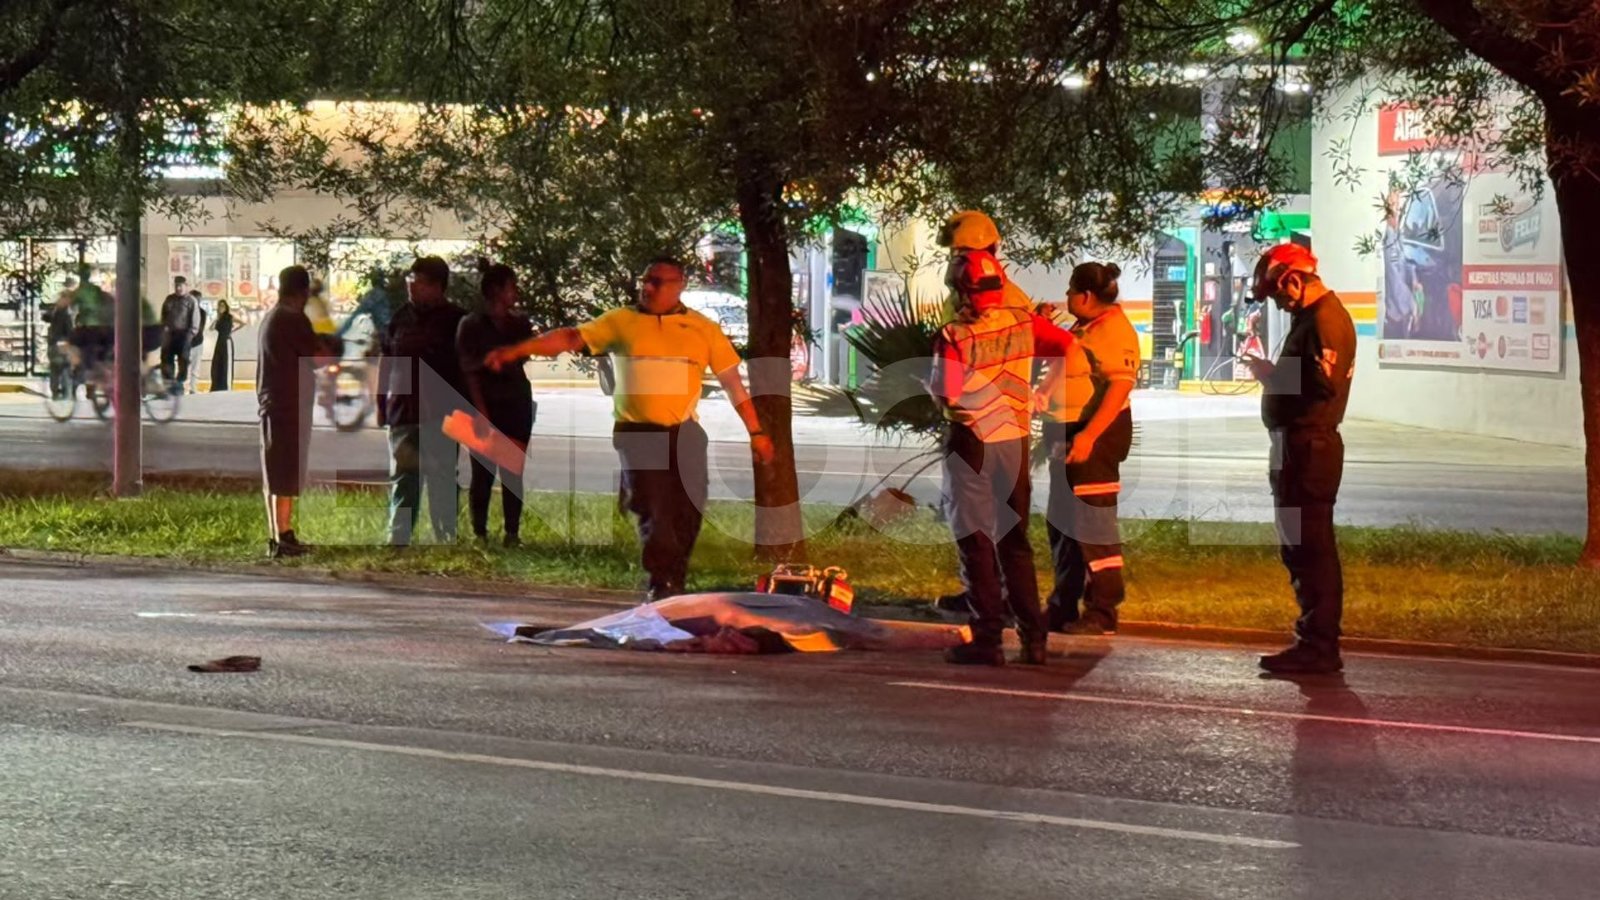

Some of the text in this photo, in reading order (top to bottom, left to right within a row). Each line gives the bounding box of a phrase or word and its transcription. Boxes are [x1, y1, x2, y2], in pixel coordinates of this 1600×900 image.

[1468, 271, 1554, 285] NUESTRAS FORMAS DE PAGO
[1472, 299, 1493, 319] VISA
